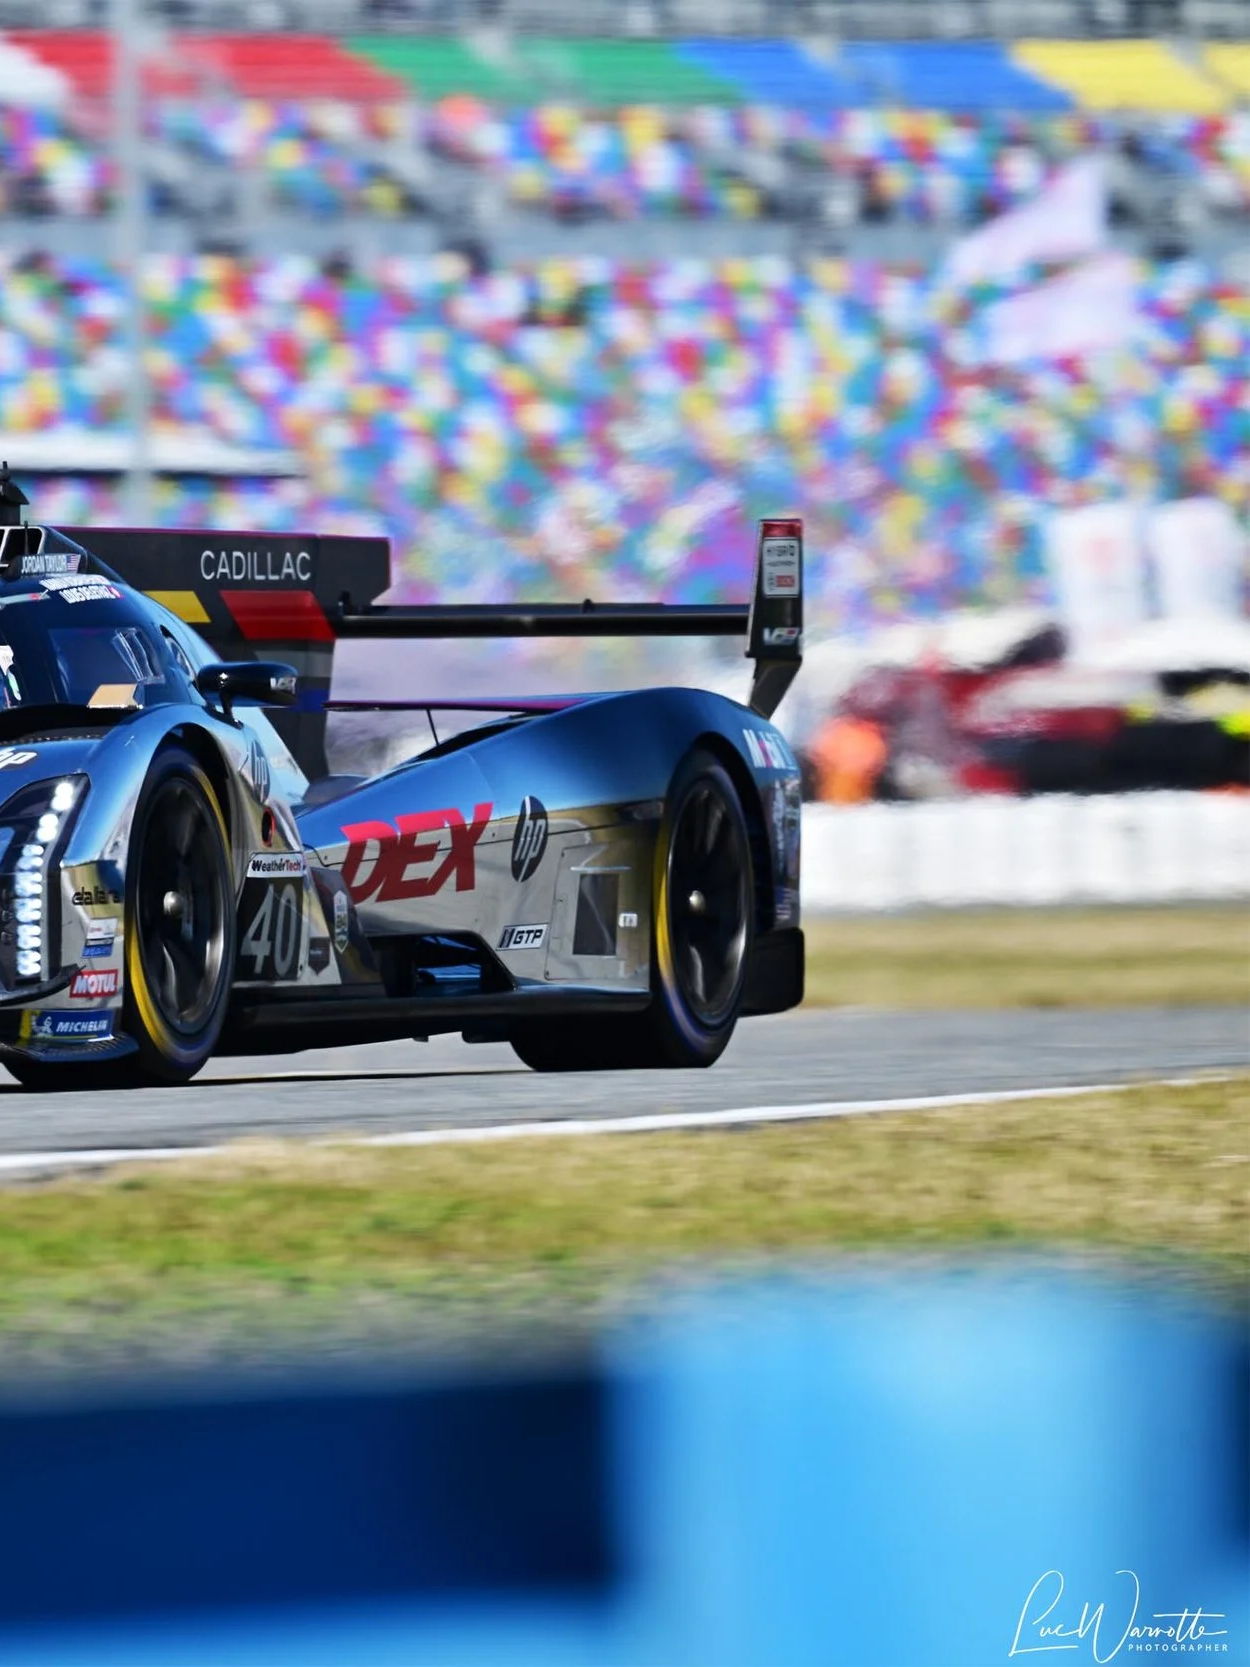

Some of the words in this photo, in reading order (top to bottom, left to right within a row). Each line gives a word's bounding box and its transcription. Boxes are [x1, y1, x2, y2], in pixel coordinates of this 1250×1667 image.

[21, 555, 44, 573] JORDAN
[45, 554, 67, 573] TAYLOR
[200, 550, 311, 580] CADILLAC
[514, 796, 547, 882] hp
[339, 802, 493, 904] DEX
[252, 857, 301, 873] WeatherTech
[240, 884, 297, 977] 40
[513, 929, 543, 944] GTP
[73, 973, 116, 994] MOTUL
[56, 1018, 109, 1032] MICHELIN
